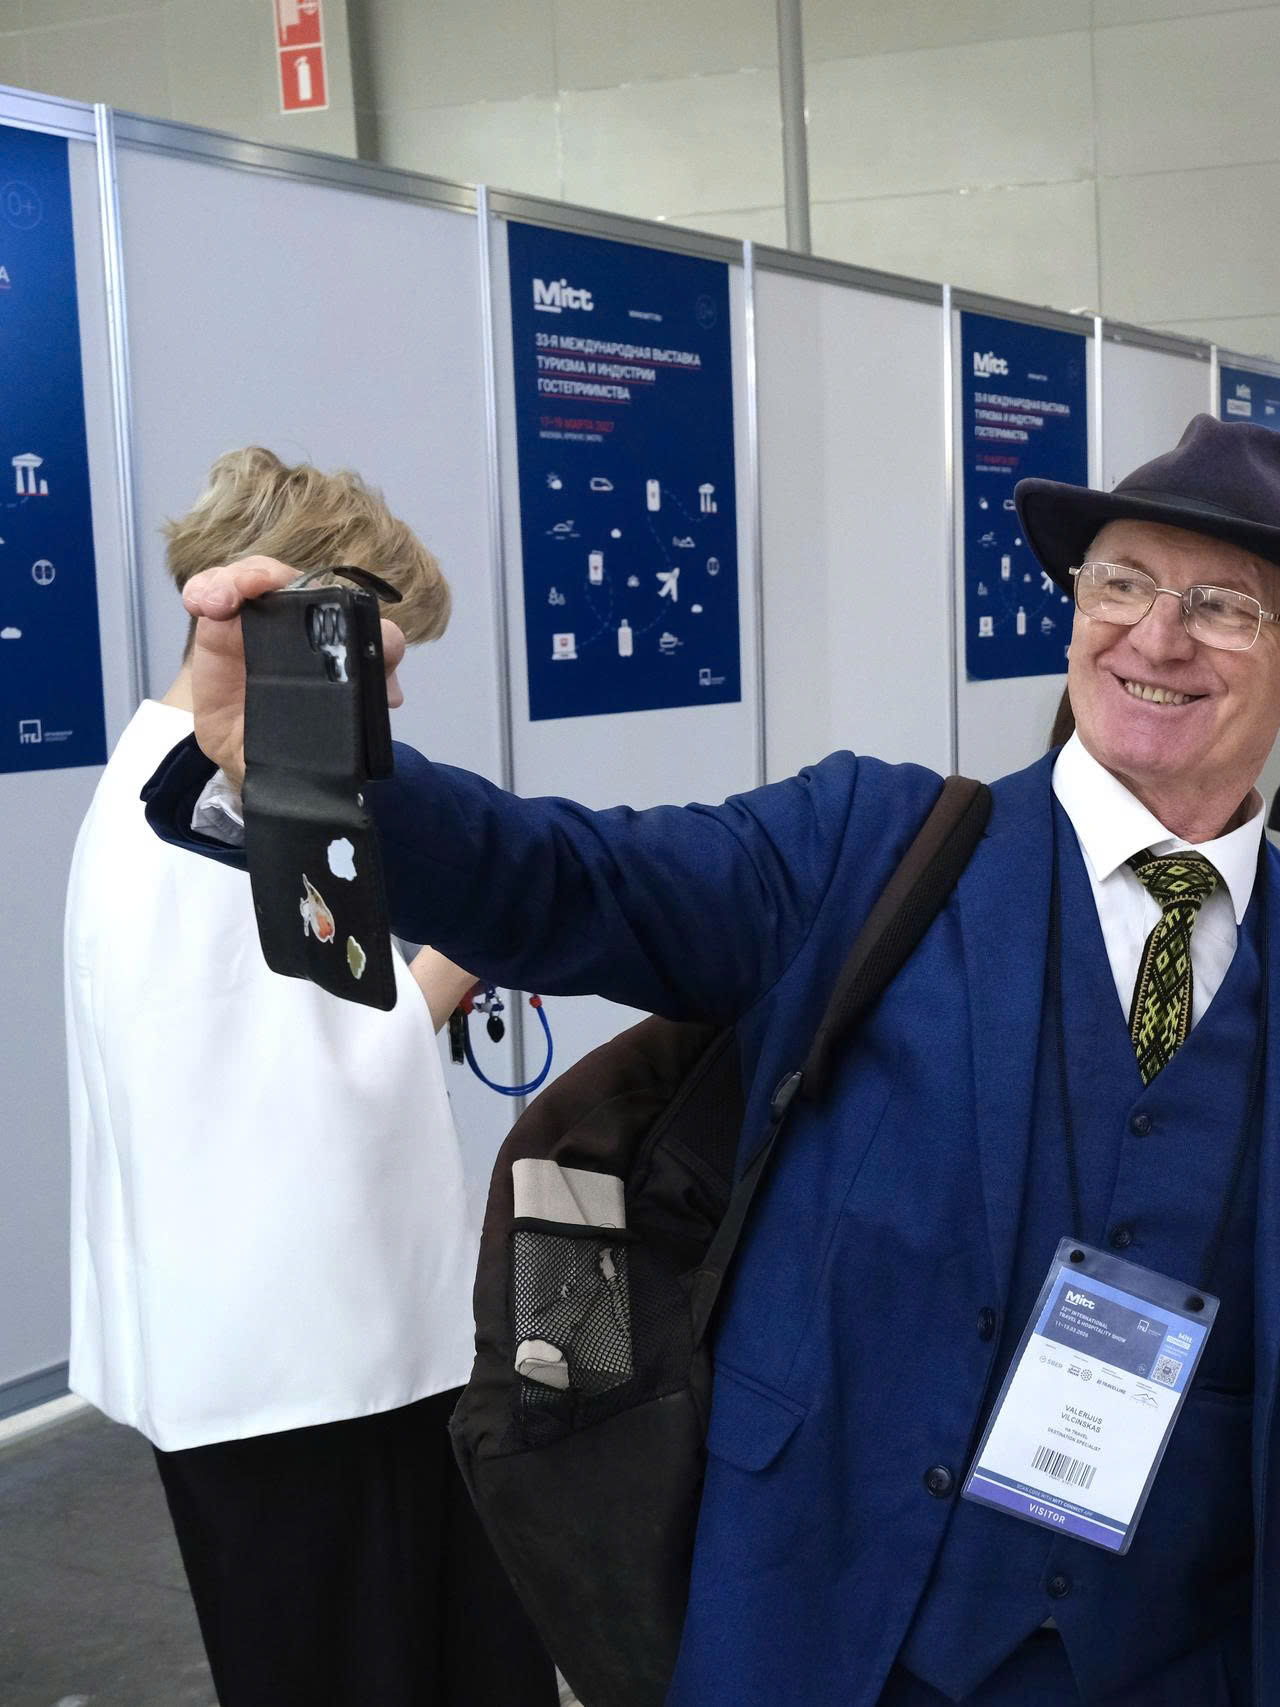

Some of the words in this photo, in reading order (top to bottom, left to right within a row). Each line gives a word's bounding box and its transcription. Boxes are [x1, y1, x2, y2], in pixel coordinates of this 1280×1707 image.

[533, 278, 594, 313] Mitt
[560, 336, 651, 361] МЕЖДУНАРОДНАЯ
[652, 348, 701, 366] ВЫСТАВКА
[536, 355, 586, 373] ТУРИЗМА
[586, 361, 597, 375] И
[599, 363, 656, 381] ИНДУСТРИИ
[974, 351, 1008, 378] Mitt
[537, 378, 631, 400] ГОСТЕПРИИМСТВА
[1065, 1290, 1096, 1310] Mitt
[1059, 1312, 1077, 1323] TRAVEL
[1071, 1309, 1108, 1329] INTERNATIONAL
[1065, 1404, 1103, 1425] VALERIJUS
[1029, 1503, 1066, 1524] VISITOR
